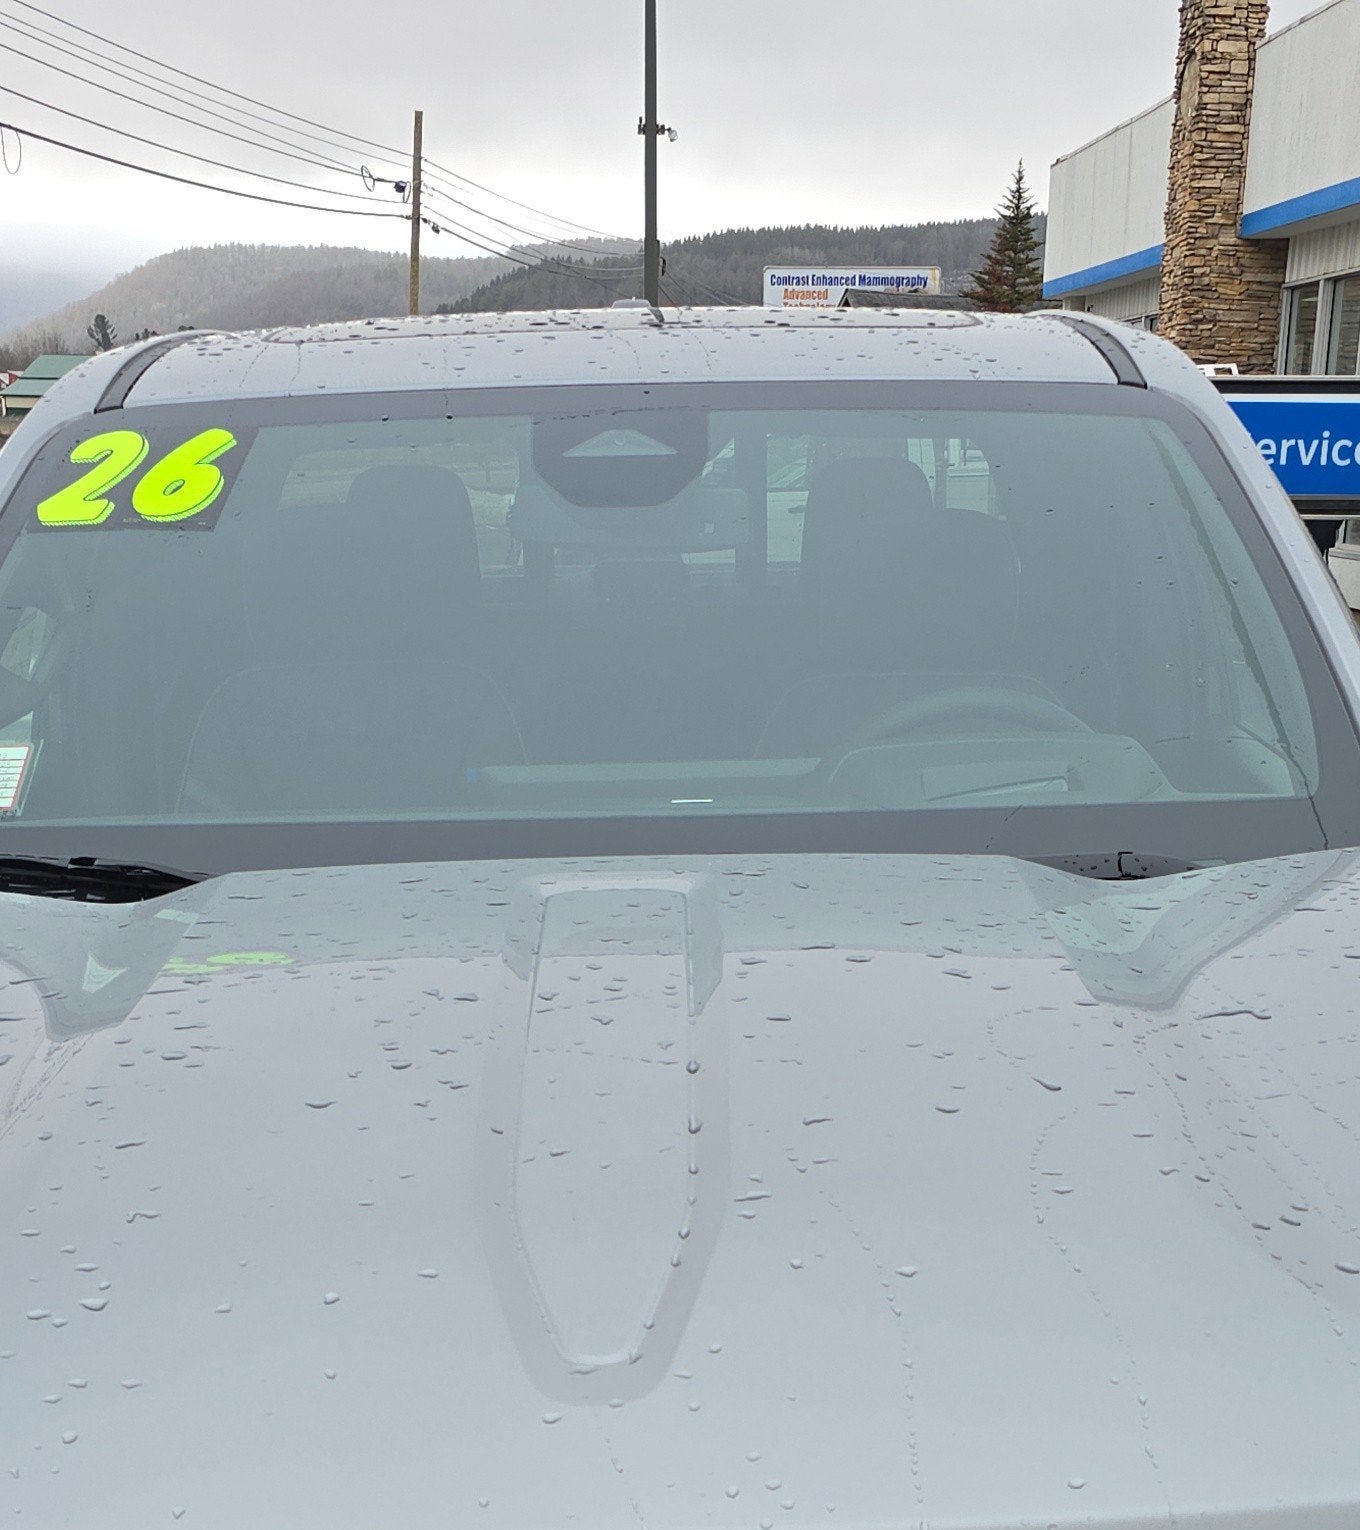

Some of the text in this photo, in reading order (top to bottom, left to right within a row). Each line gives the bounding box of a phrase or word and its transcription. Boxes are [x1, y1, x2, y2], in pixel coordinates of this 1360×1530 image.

[770, 273, 928, 288] Contrast Enhanced Mammography
[783, 288, 828, 300] Advanced
[36, 427, 238, 527] 26
